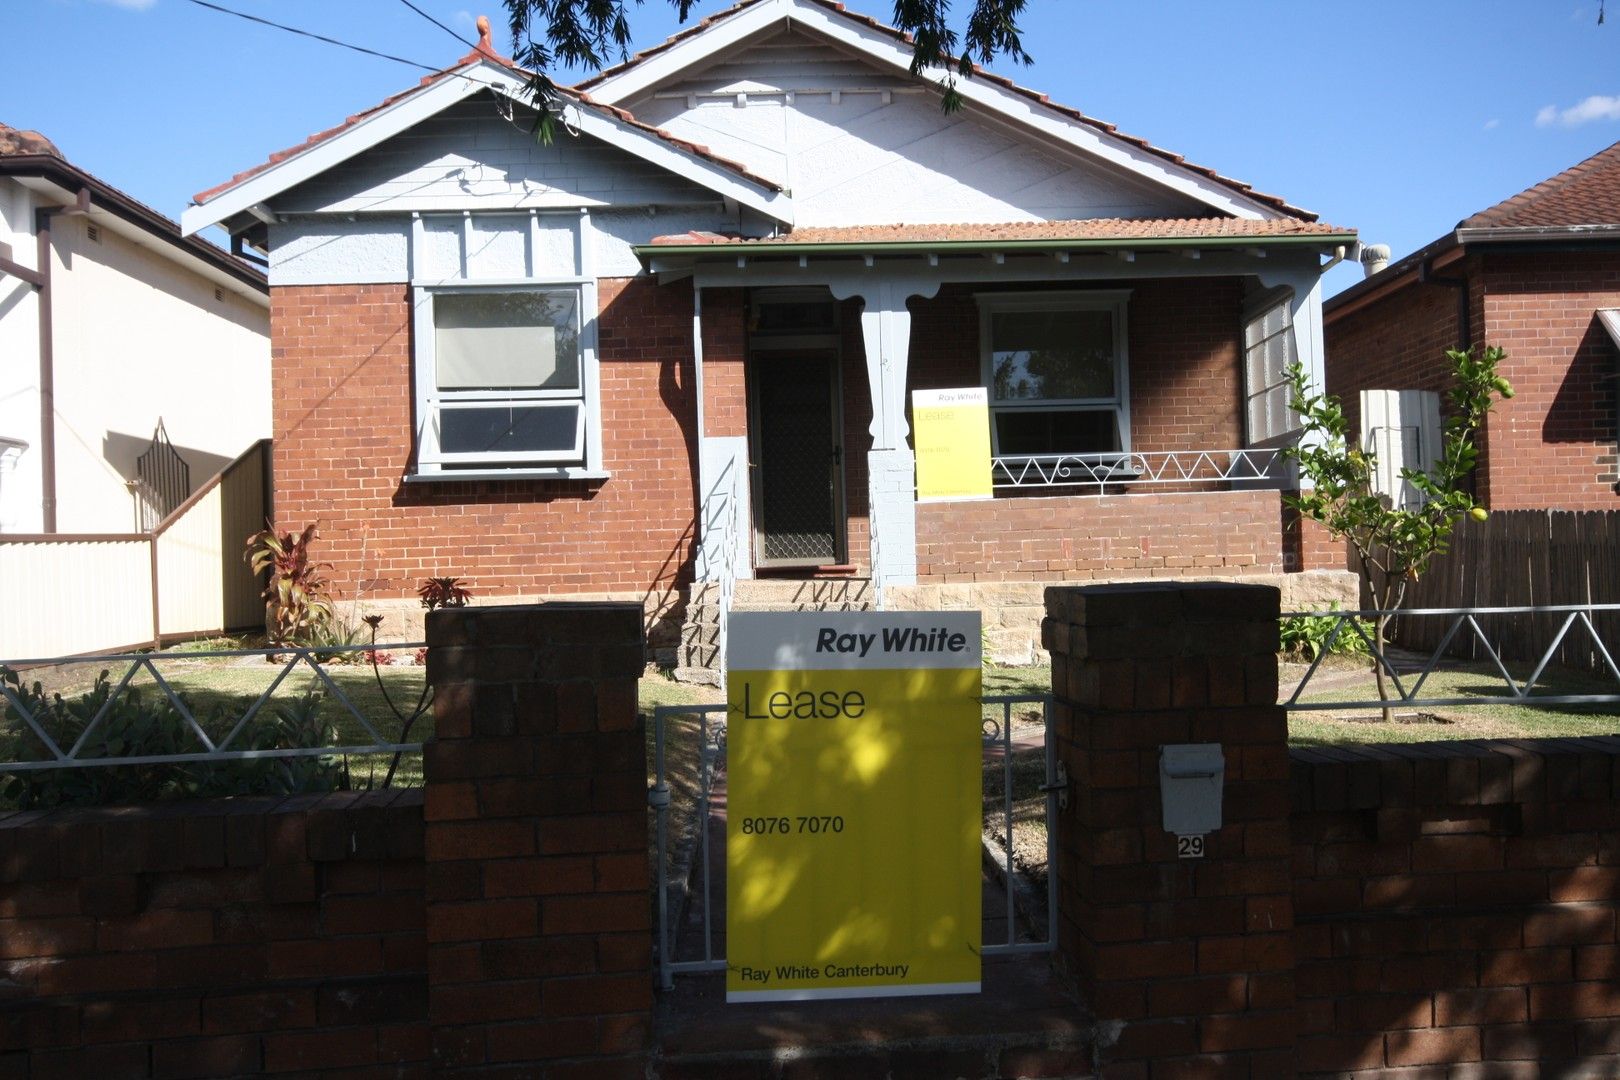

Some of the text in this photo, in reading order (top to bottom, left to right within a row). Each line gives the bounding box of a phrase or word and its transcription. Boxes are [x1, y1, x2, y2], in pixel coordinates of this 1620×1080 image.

[938, 392, 983, 402] Ray White
[919, 410, 954, 421] Lease
[816, 627, 966, 657] Ray White
[744, 682, 866, 720] Lease
[742, 815, 844, 835] 8076 7070
[1179, 837, 1203, 856] 29
[741, 962, 909, 984] Ray White Canterbury
